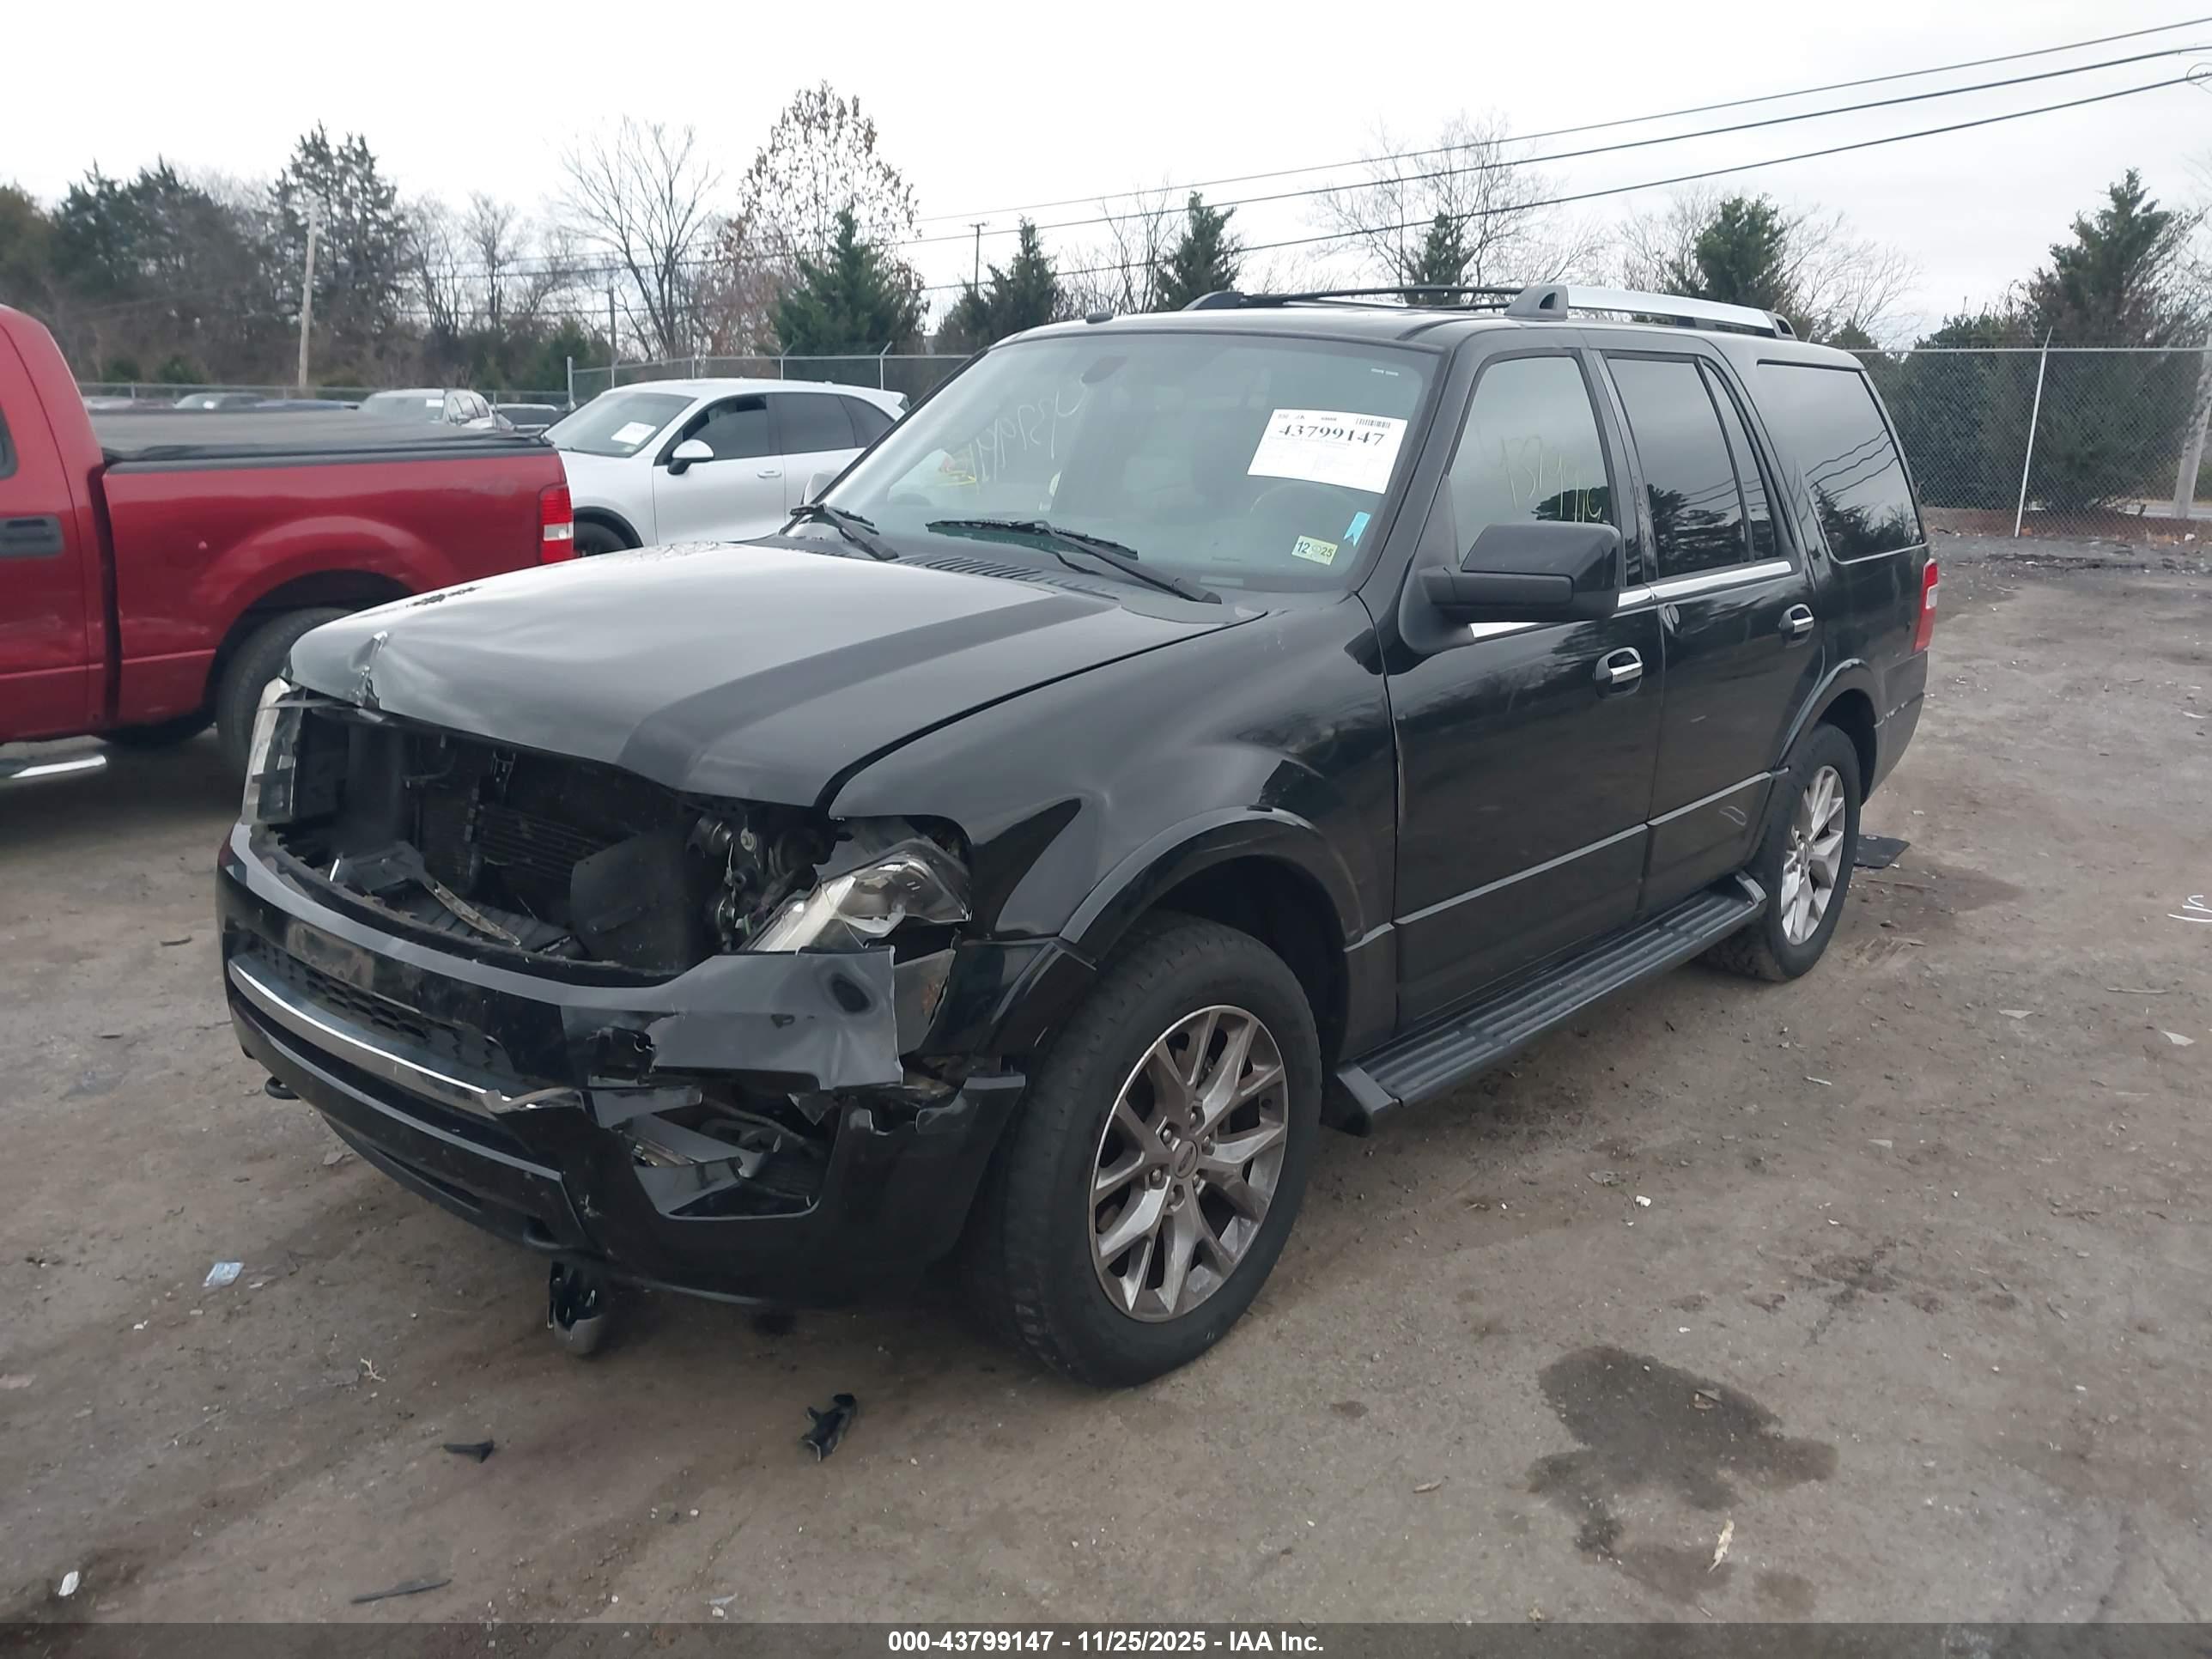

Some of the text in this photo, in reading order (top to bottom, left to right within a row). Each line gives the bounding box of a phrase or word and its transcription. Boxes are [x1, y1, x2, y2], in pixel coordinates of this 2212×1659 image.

[1279, 424, 1385, 446] 43799147
[1297, 541, 1334, 557] 12 25
